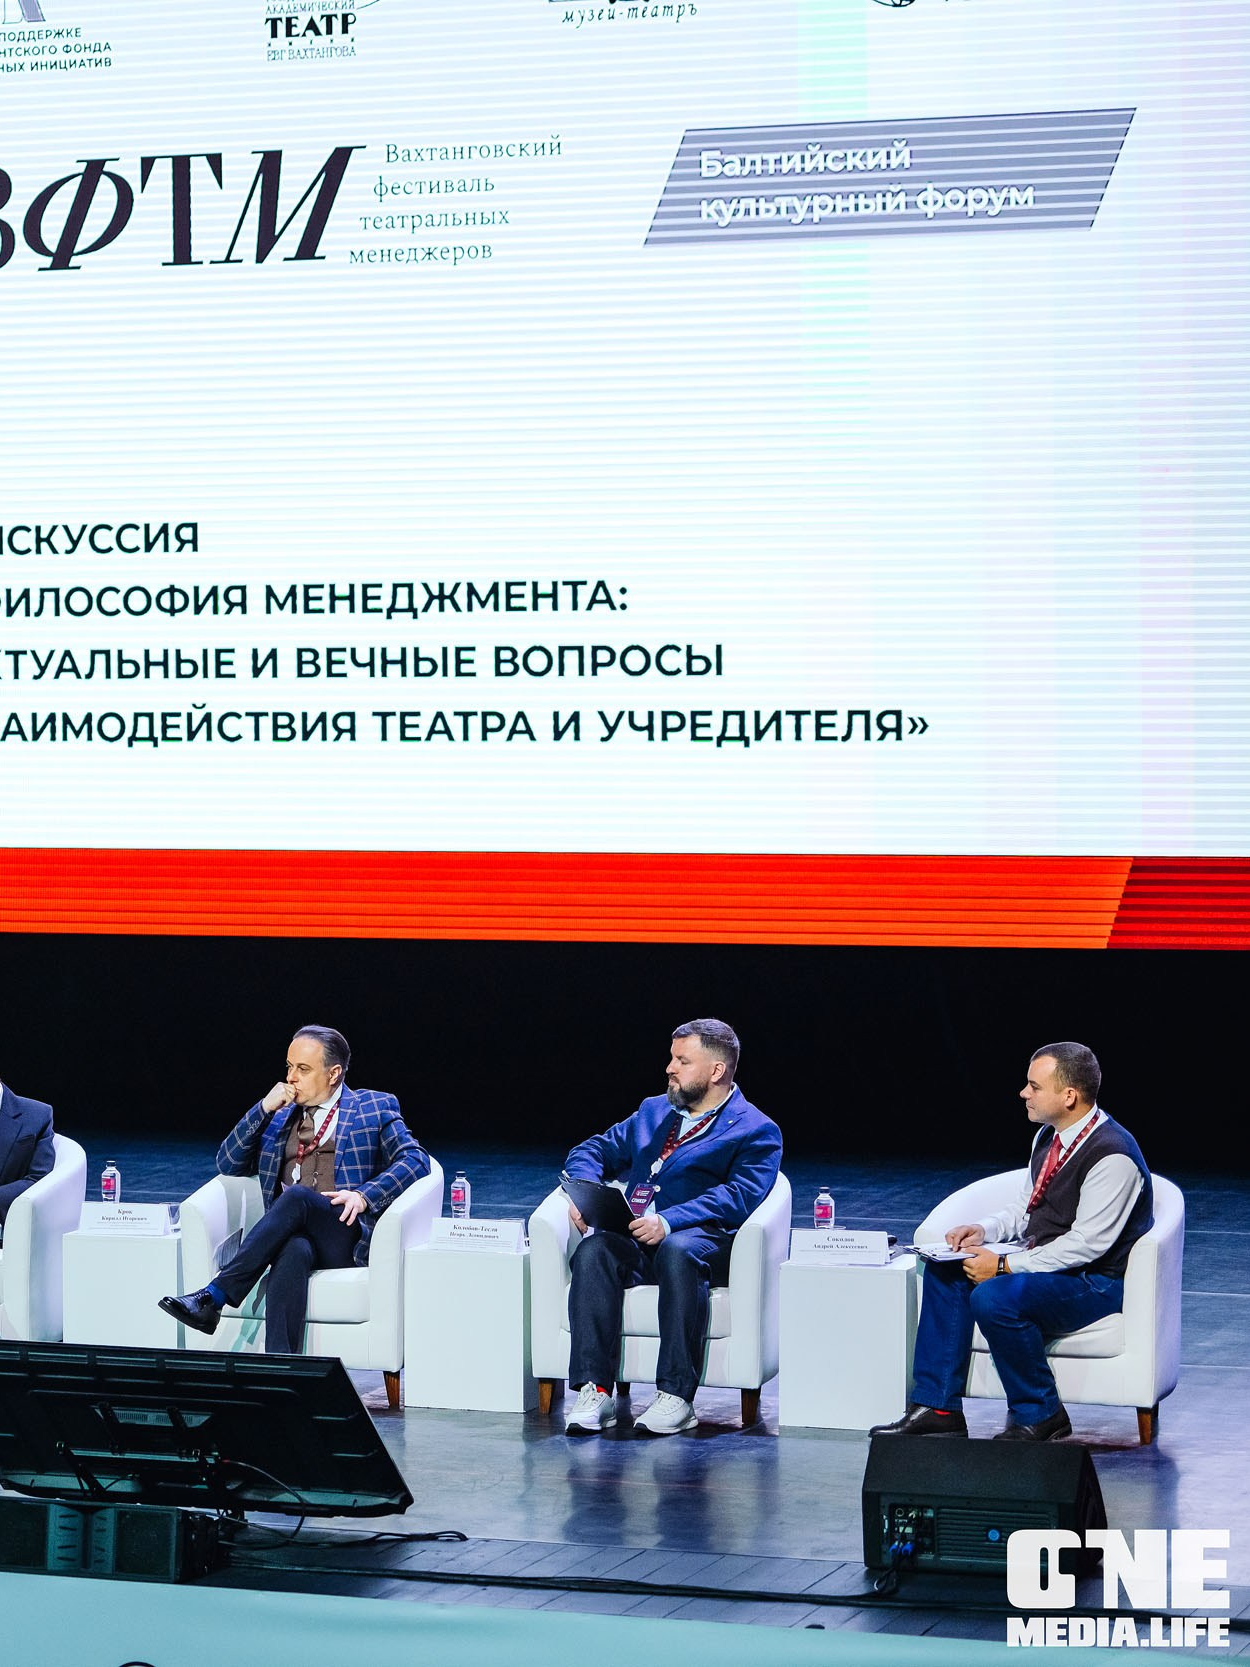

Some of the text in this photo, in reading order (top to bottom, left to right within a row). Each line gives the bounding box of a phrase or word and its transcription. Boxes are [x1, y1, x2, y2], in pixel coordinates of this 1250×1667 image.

[264, 12, 357, 39] ТЕАТР
[62, 42, 112, 54] ФОНДА
[30, 57, 112, 71] ИНИЦИАТИВ
[386, 134, 562, 163] Вахтанговский
[700, 139, 912, 178] Балтийский
[373, 175, 495, 203] фестиваль
[700, 182, 1035, 227] культурный форум
[359, 211, 510, 234] театральных
[349, 244, 493, 266] менеджеров
[266, 580, 628, 620] МЕНЕДЖМЕНТА:
[251, 648, 278, 679] И
[297, 645, 477, 679] ВЕЧНЫЕ
[494, 644, 724, 678] ВОПРОСЫ
[370, 709, 537, 742] ТЕАТРА
[553, 709, 579, 742] И
[599, 708, 929, 748] УЧРЕДИТЕЛЯ»
